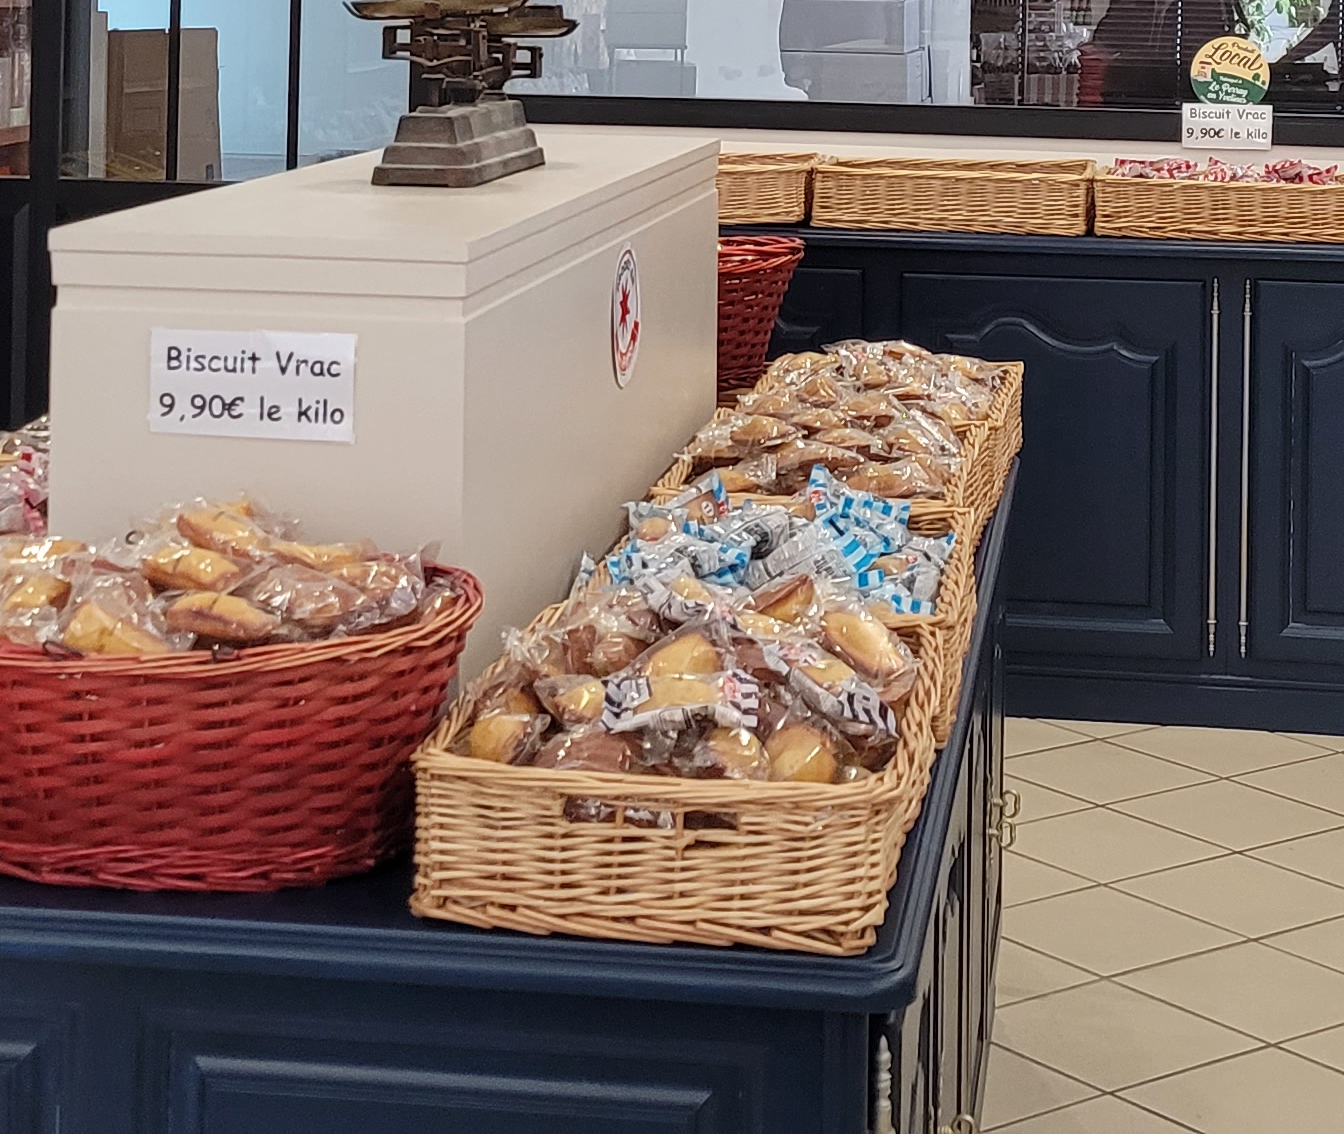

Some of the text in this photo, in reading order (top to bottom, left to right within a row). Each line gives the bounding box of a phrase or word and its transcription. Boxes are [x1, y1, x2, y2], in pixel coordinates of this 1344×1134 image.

[1204, 42, 1264, 71] Local
[1189, 107, 1267, 120] Biscuit Vrac
[1186, 127, 1268, 140] 9,90€ le kilo
[166, 346, 341, 378] Biscuit Vrac
[159, 392, 345, 425] 9,90€ le kilo
